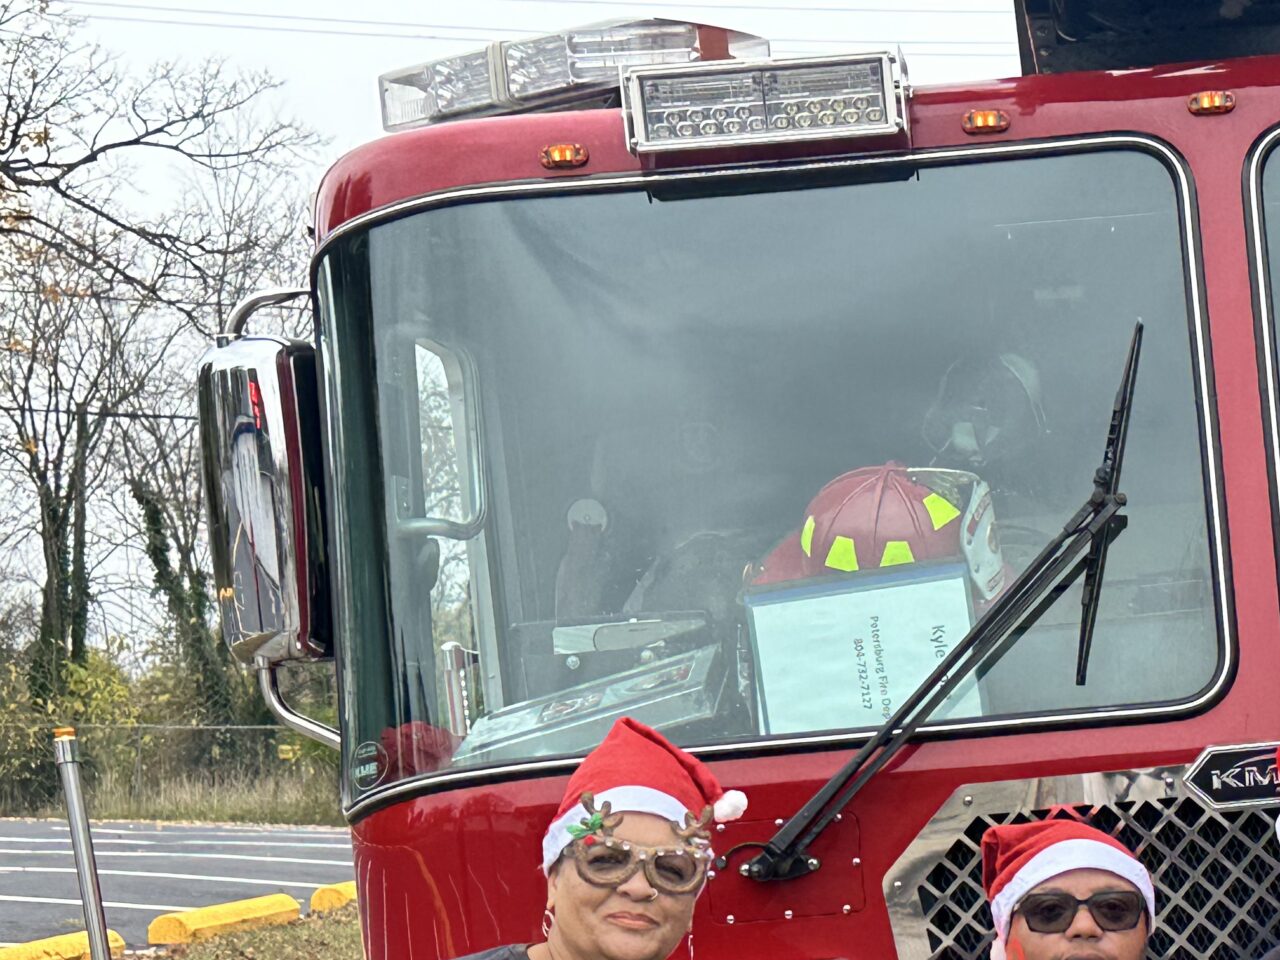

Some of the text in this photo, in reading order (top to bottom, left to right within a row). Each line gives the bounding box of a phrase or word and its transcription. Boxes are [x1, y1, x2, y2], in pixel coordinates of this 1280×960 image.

[930, 625, 948, 659] Kyle
[854, 638, 873, 710] 804-732-7127
[880, 698, 893, 720] Dep
